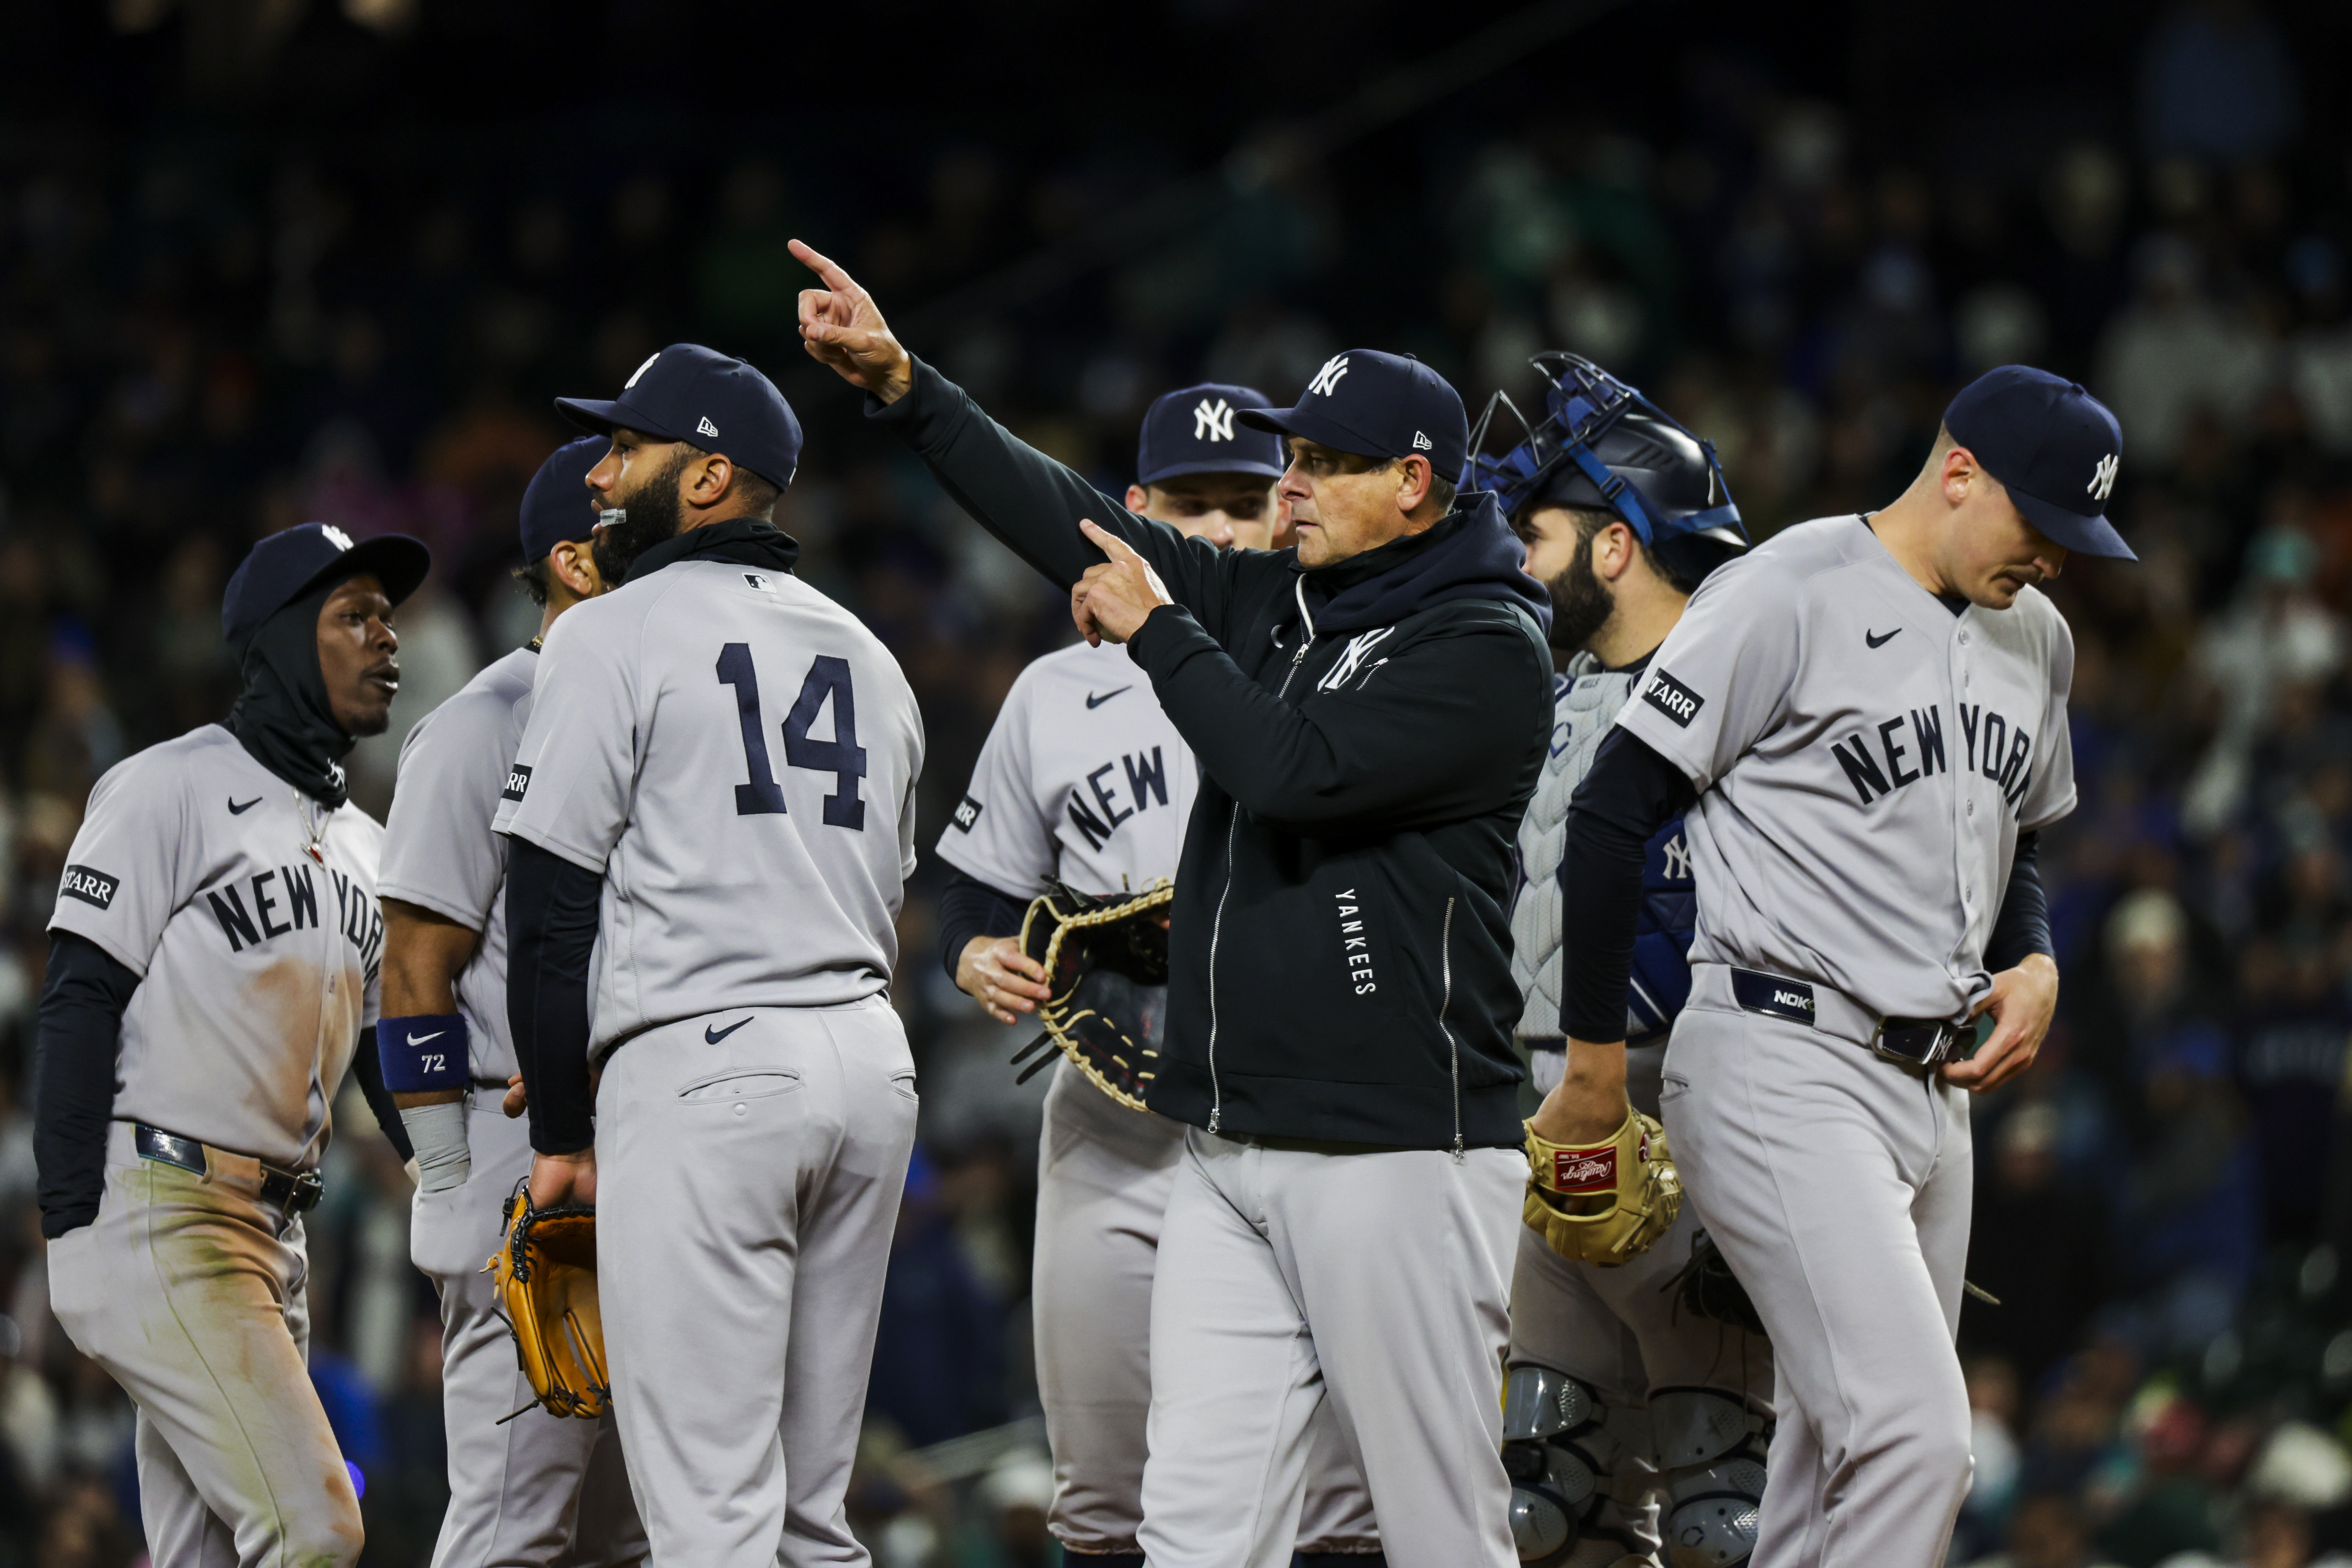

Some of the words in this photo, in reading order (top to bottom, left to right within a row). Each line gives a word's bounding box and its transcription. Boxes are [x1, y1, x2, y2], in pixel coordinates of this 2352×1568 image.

[1308, 354, 1349, 397] NY
[1193, 398, 1235, 442] NY
[2087, 453, 2119, 500] NY
[716, 643, 867, 831] 14
[1831, 705, 1946, 805] NEW
[1067, 745, 1169, 853] NEW
[206, 864, 318, 952] NEW
[1335, 888, 1376, 995] YANKEES
[421, 1054, 446, 1073] 72
[1560, 1161, 1612, 1182] Rawlings
